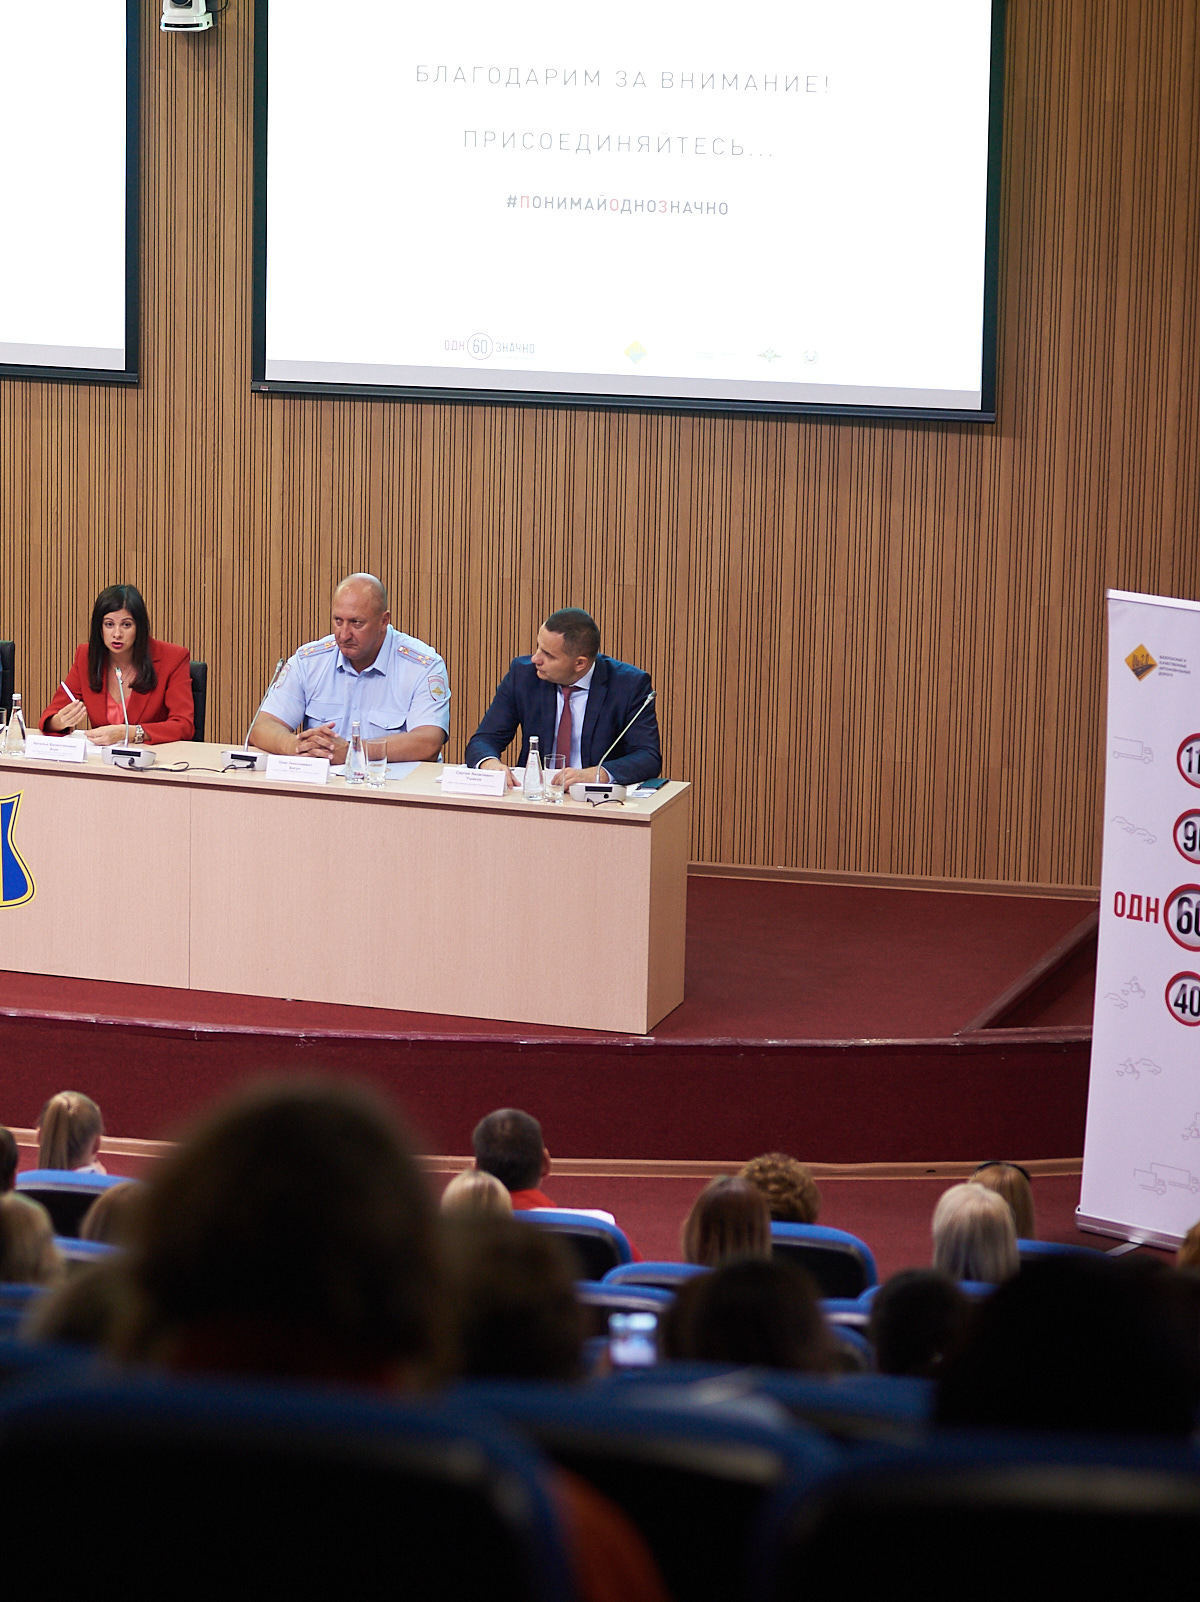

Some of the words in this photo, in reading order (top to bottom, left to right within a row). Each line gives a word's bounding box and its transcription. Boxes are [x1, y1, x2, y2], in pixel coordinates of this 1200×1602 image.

[415, 64, 601, 89] БЛАГОДАРИМ
[615, 69, 647, 89] ЗА
[661, 72, 831, 94] ВНИМАНИЕ!
[463, 129, 775, 159] ПРИСОЕДИНЯЙТЕСЬ...
[506, 192, 730, 216] #ПОНИМАЙОДНОЗНАЧНО
[1183, 820, 1200, 852] 9
[1113, 891, 1160, 924] ОДН
